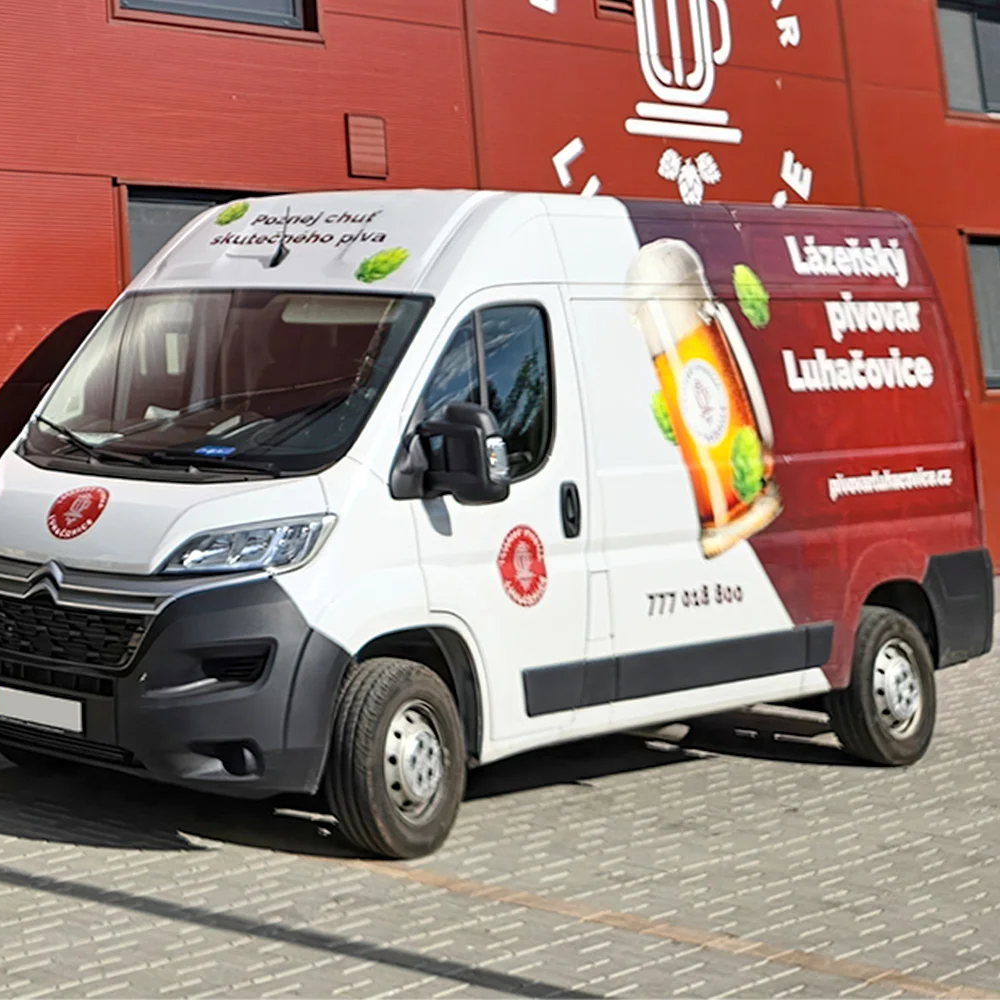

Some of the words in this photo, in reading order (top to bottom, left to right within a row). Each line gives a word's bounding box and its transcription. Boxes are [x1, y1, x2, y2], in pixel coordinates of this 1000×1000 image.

[335, 229, 388, 248] piva
[784, 235, 910, 289] Lázeňský
[823, 291, 922, 344] pivovar
[781, 347, 935, 393] Luhačovice
[646, 590, 677, 616] 777
